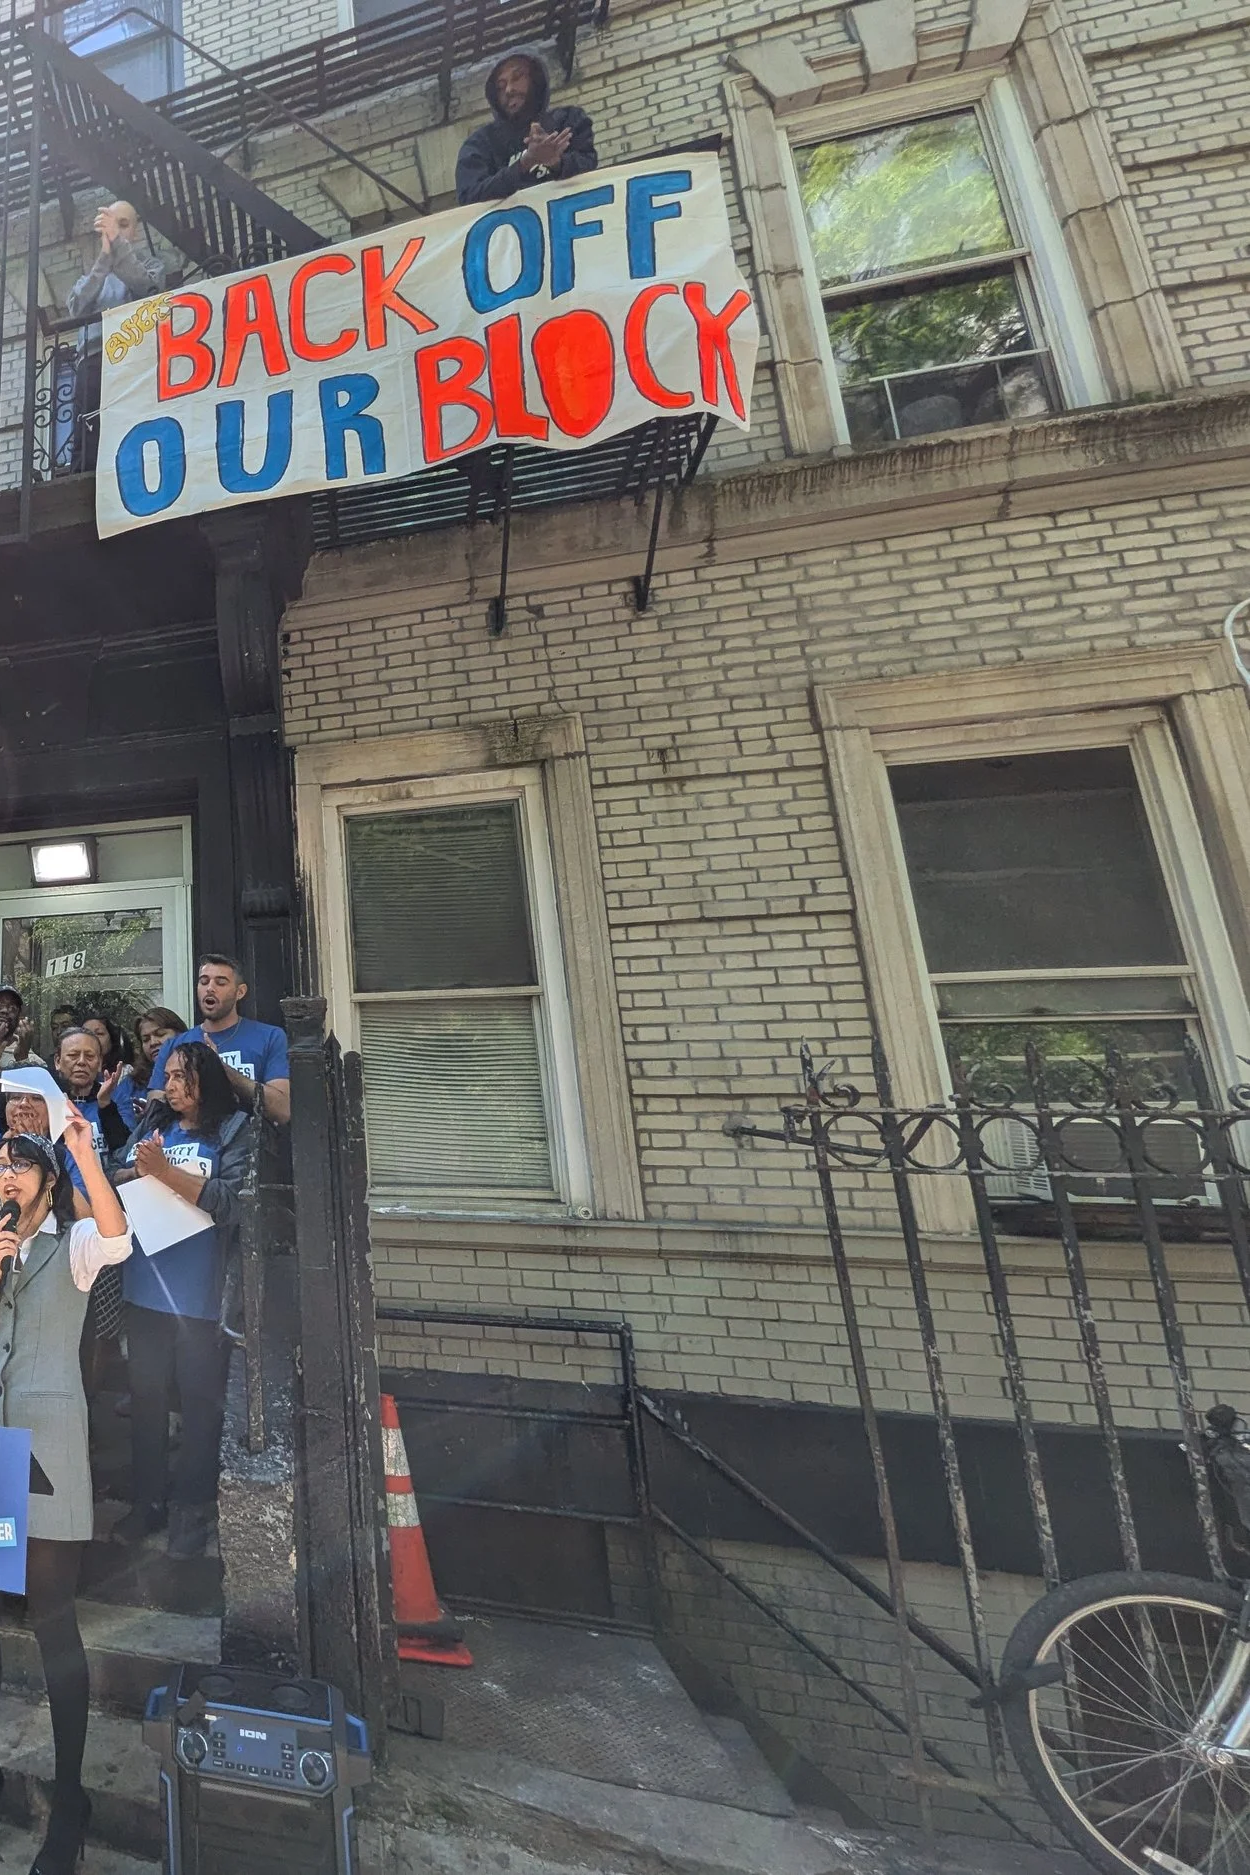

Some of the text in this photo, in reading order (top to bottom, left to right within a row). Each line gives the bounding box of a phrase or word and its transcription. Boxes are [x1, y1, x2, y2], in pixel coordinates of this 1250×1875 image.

[157, 170, 693, 402] BACK OFF
[115, 281, 751, 517] OUR BLOCK
[49, 952, 84, 976] 118
[239, 1728, 267, 1741] ION
